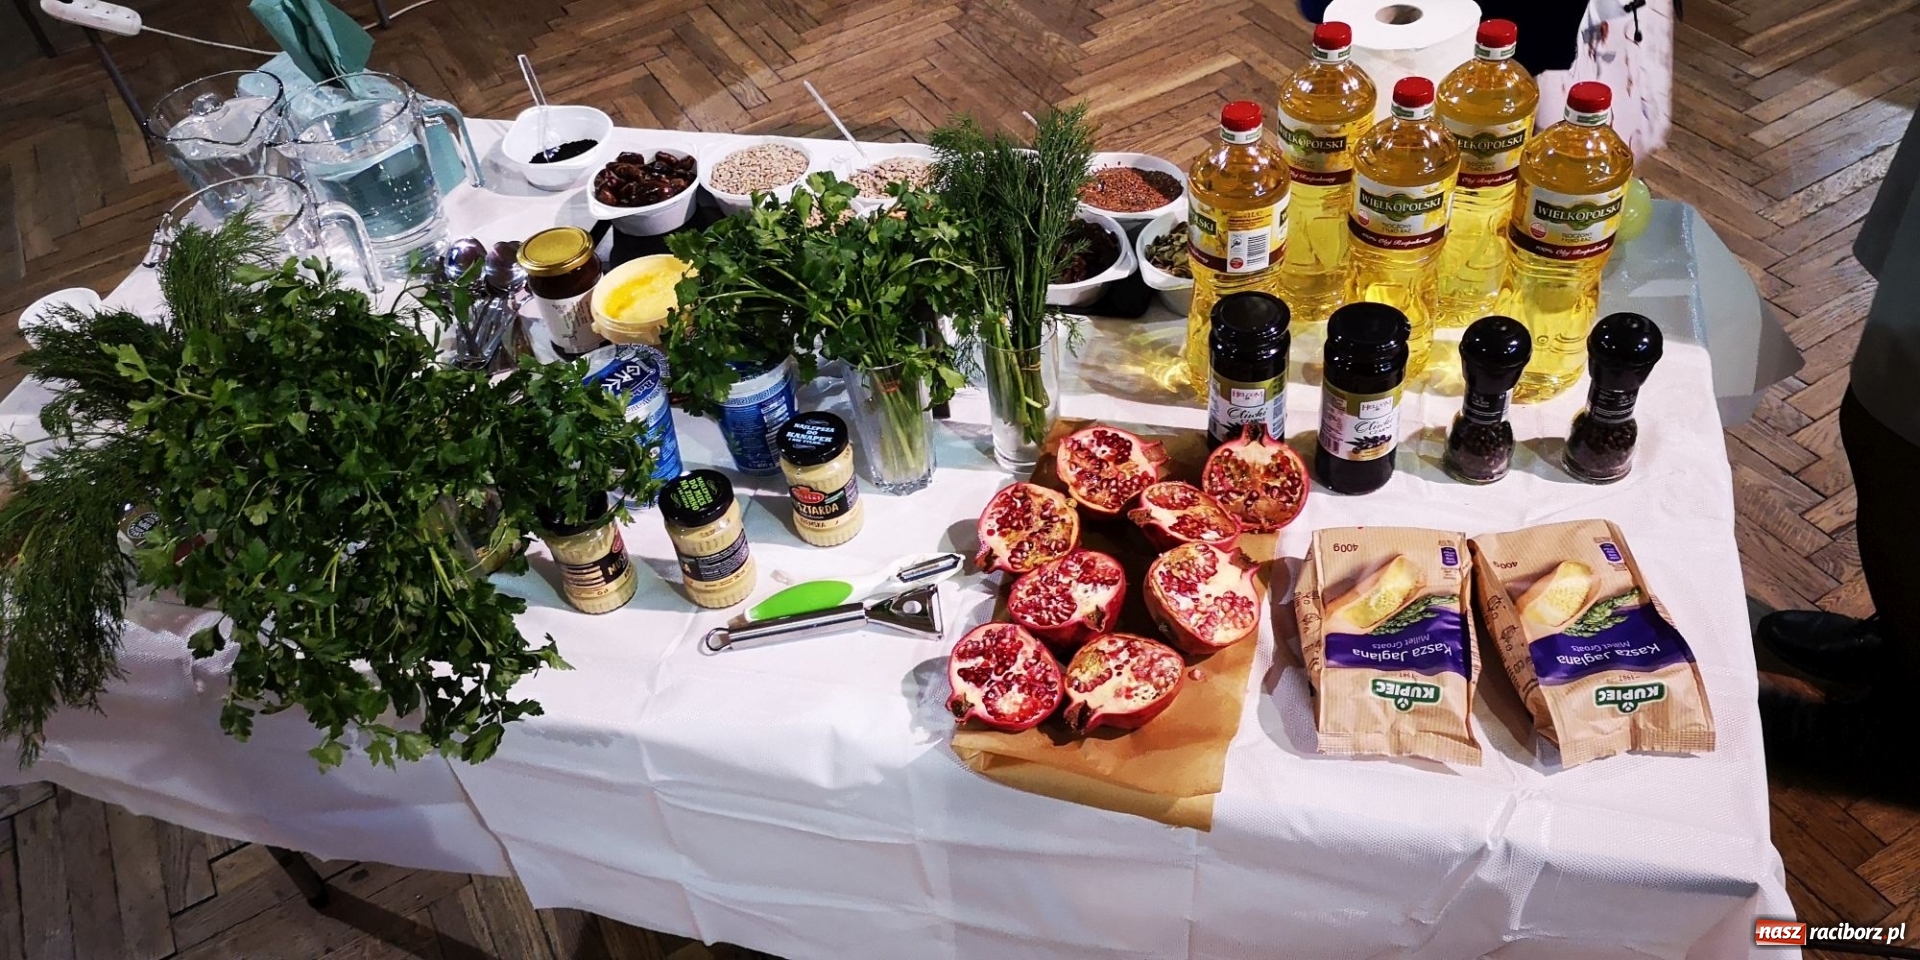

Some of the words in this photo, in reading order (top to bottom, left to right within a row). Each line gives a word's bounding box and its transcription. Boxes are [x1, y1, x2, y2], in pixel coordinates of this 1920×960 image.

[1458, 134, 1523, 150] ELKOPOLSKI
[1361, 193, 1441, 212] WIELKOPOLSKI
[1538, 202, 1621, 221] WIELKOPOLSKI
[1226, 407, 1268, 420] Oliwki
[793, 423, 835, 433] NAJLEPSZA
[786, 431, 833, 443] KANAPEK
[680, 480, 689, 490] NA
[688, 479, 698, 490] DO
[684, 489, 700, 511] ZIMNO
[796, 502, 839, 516] SZTARDA
[1333, 542, 1359, 553] 400g
[1492, 560, 1518, 570] 400g
[1404, 633, 1431, 646] Millet
[1603, 640, 1631, 650] Millet
[1352, 648, 1408, 662] Jaglana
[1412, 642, 1453, 658] Kasza
[1570, 645, 1602, 653] Groats
[1615, 642, 1661, 657] Kasza
[1556, 651, 1611, 666] Jaglana
[1375, 681, 1436, 699] KUPIEC
[1598, 686, 1660, 701] KUPIEC
